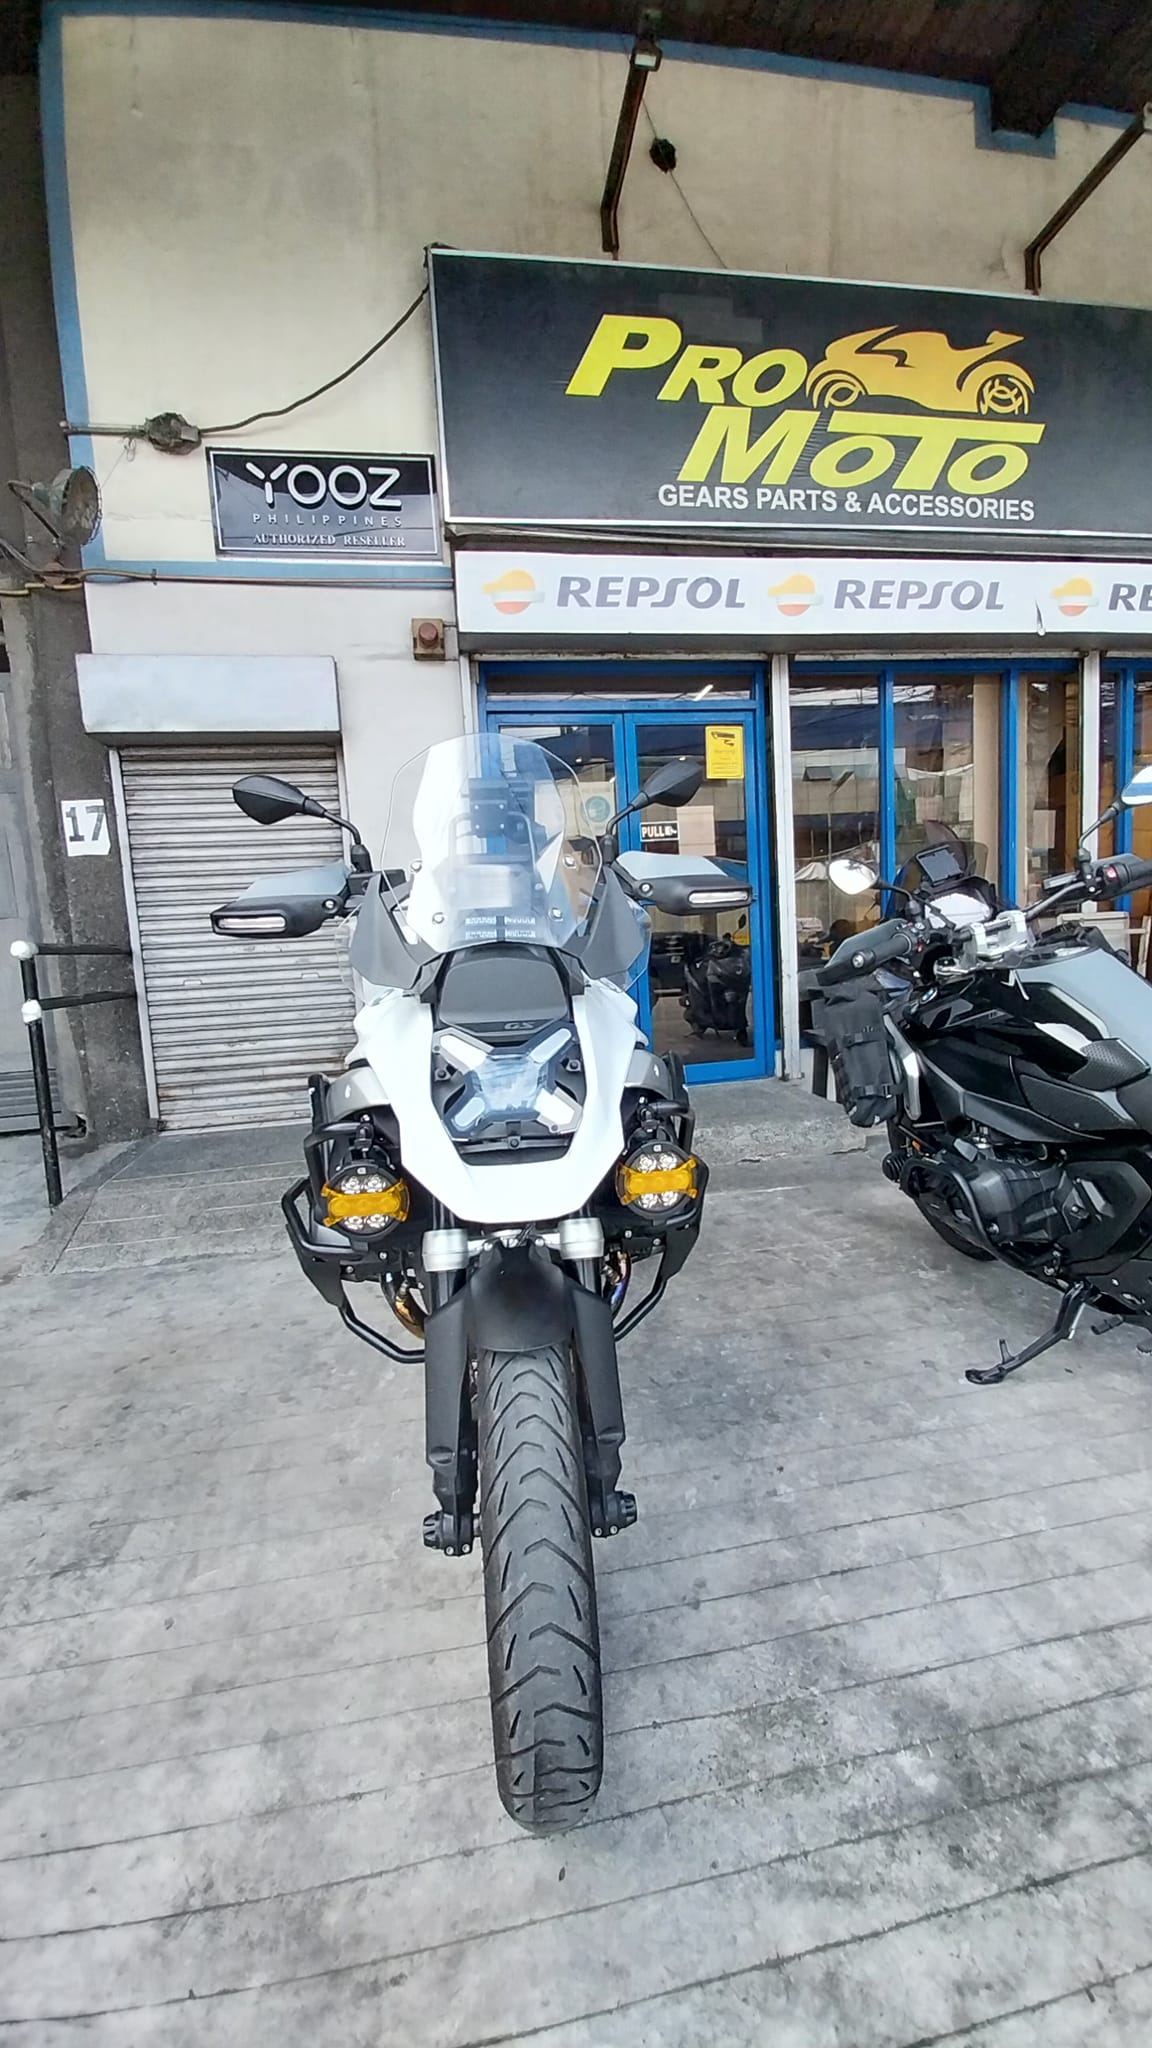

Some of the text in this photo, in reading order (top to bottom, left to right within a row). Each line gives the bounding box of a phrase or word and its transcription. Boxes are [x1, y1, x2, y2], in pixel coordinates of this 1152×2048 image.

[245, 462, 402, 505] YOOZ
[658, 484, 1035, 521] GEARS PARTS & ACCESSORIES
[252, 513, 402, 527] PHILIPPINES
[252, 534, 406, 548] AUTHORIZED RESELLER
[557, 576, 746, 609] REPSOL
[834, 579, 1004, 611] REPSOL
[65, 805, 106, 841] 17
[641, 825, 665, 838] PULL
